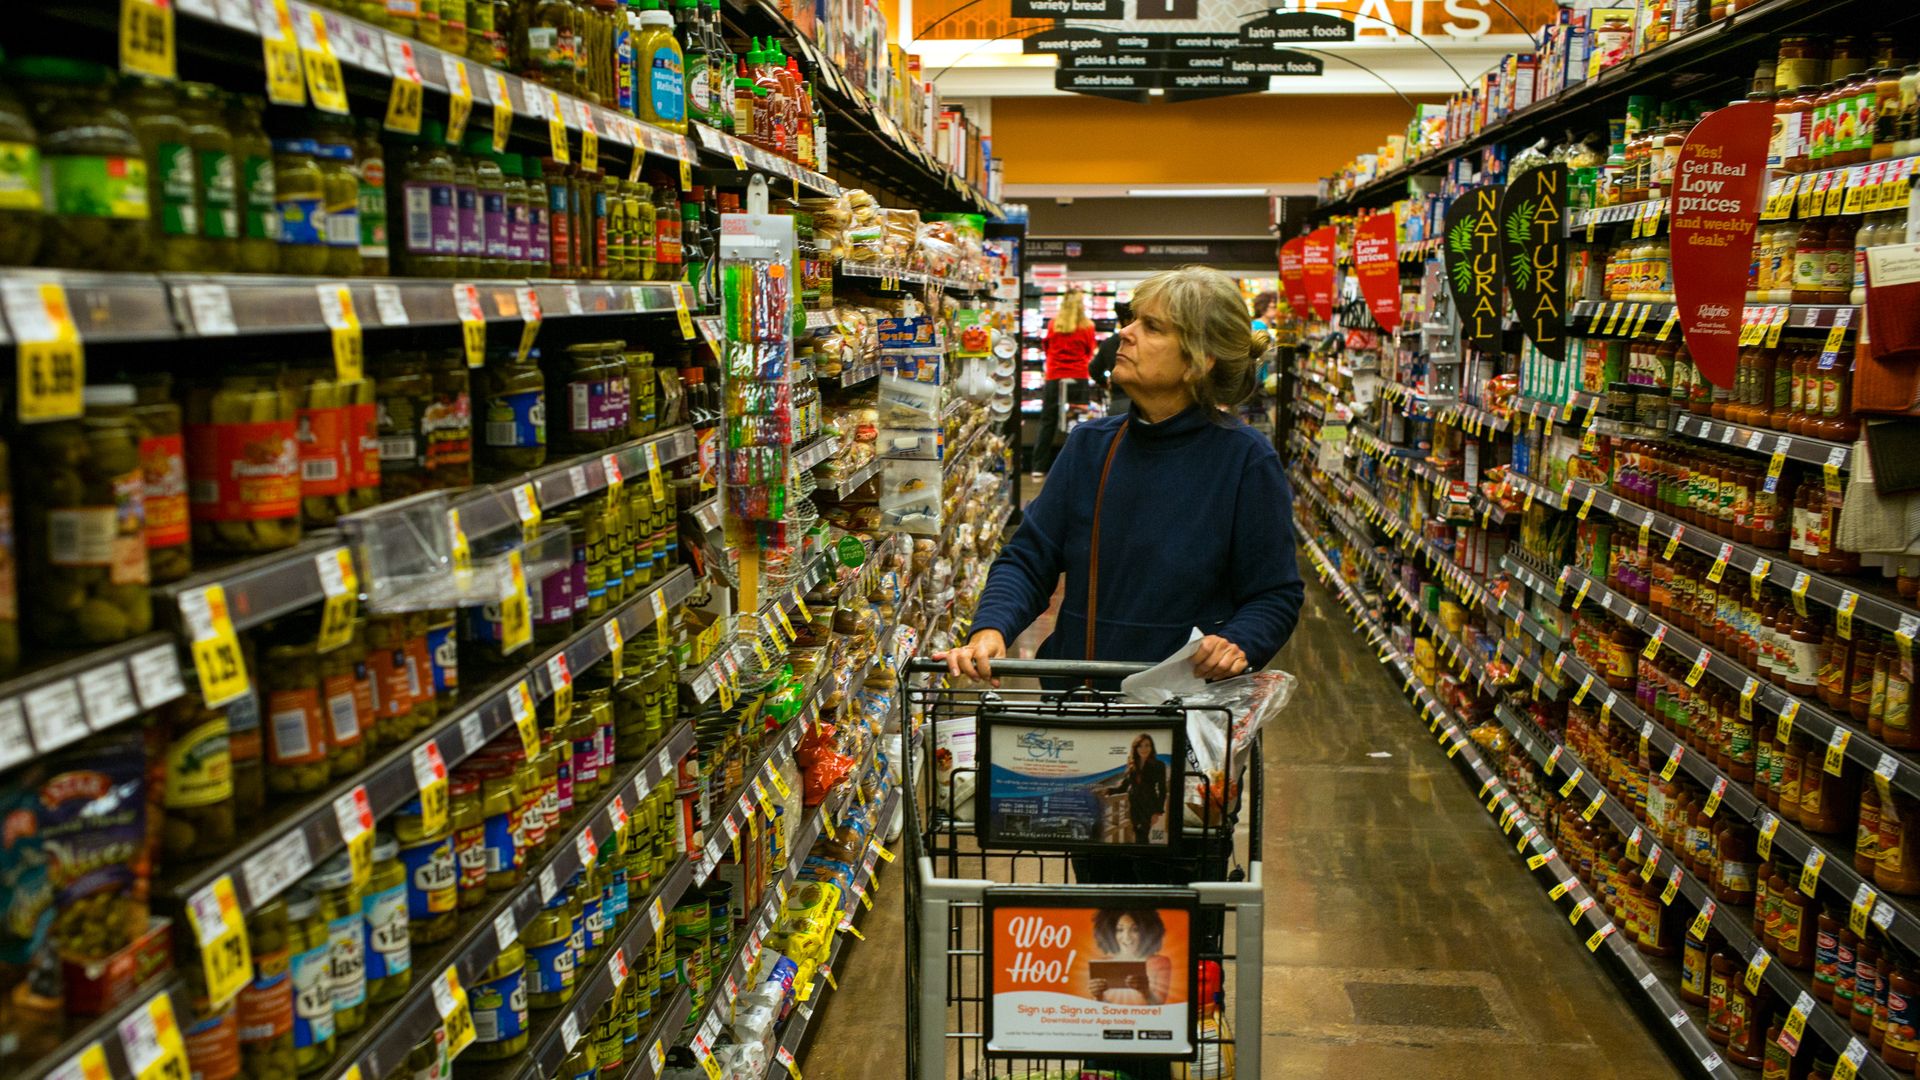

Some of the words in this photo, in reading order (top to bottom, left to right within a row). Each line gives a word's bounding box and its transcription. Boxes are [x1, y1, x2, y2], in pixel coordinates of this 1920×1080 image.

[1030, 0, 1070, 13] variety
[1072, 0, 1106, 11] bread
[1284, 0, 1492, 37] EATS
[1248, 26, 1275, 39] latin
[1277, 28, 1310, 38] amer.
[1312, 25, 1347, 37] foods
[1037, 39, 1069, 49] sweet
[1070, 38, 1102, 51] goods
[1117, 37, 1149, 48] essing
[1175, 37, 1211, 47] canned
[1074, 55, 1107, 67] pickles
[1109, 56, 1117, 65] &
[1118, 55, 1146, 66] olives
[1189, 57, 1224, 67] canned
[1232, 61, 1255, 72] latin
[1257, 63, 1285, 72] amer.
[1286, 61, 1316, 73] foods
[1073, 75, 1100, 85] sliced
[1102, 75, 1134, 86] breads
[1175, 75, 1221, 87] spaghetti
[1222, 76, 1249, 85] sauce
[1682, 159, 1709, 175] Get
[1711, 161, 1747, 178] Real
[1680, 173, 1725, 194] Low
[1676, 195, 1741, 215] prices
[1675, 217, 1701, 230] and
[1703, 217, 1754, 236] weekly
[1357, 245, 1379, 255] Low
[1531, 169, 1560, 343] NATURAL
[1472, 189, 1498, 339] NATURAL
[1697, 303, 1731, 318] Ralphs
[1008, 916, 1072, 949] Woo
[1006, 950, 1077, 984] Hoo!
[1017, 1004, 1040, 1017] Sign
[1042, 1006, 1057, 1017] up.
[1060, 1004, 1083, 1017] Sign
[1084, 1007, 1100, 1015] on.
[1102, 1005, 1129, 1015] Save
[1131, 1005, 1162, 1015] more!
[1040, 1017, 1080, 1025] Download
[1096, 1018, 1112, 1026] App
